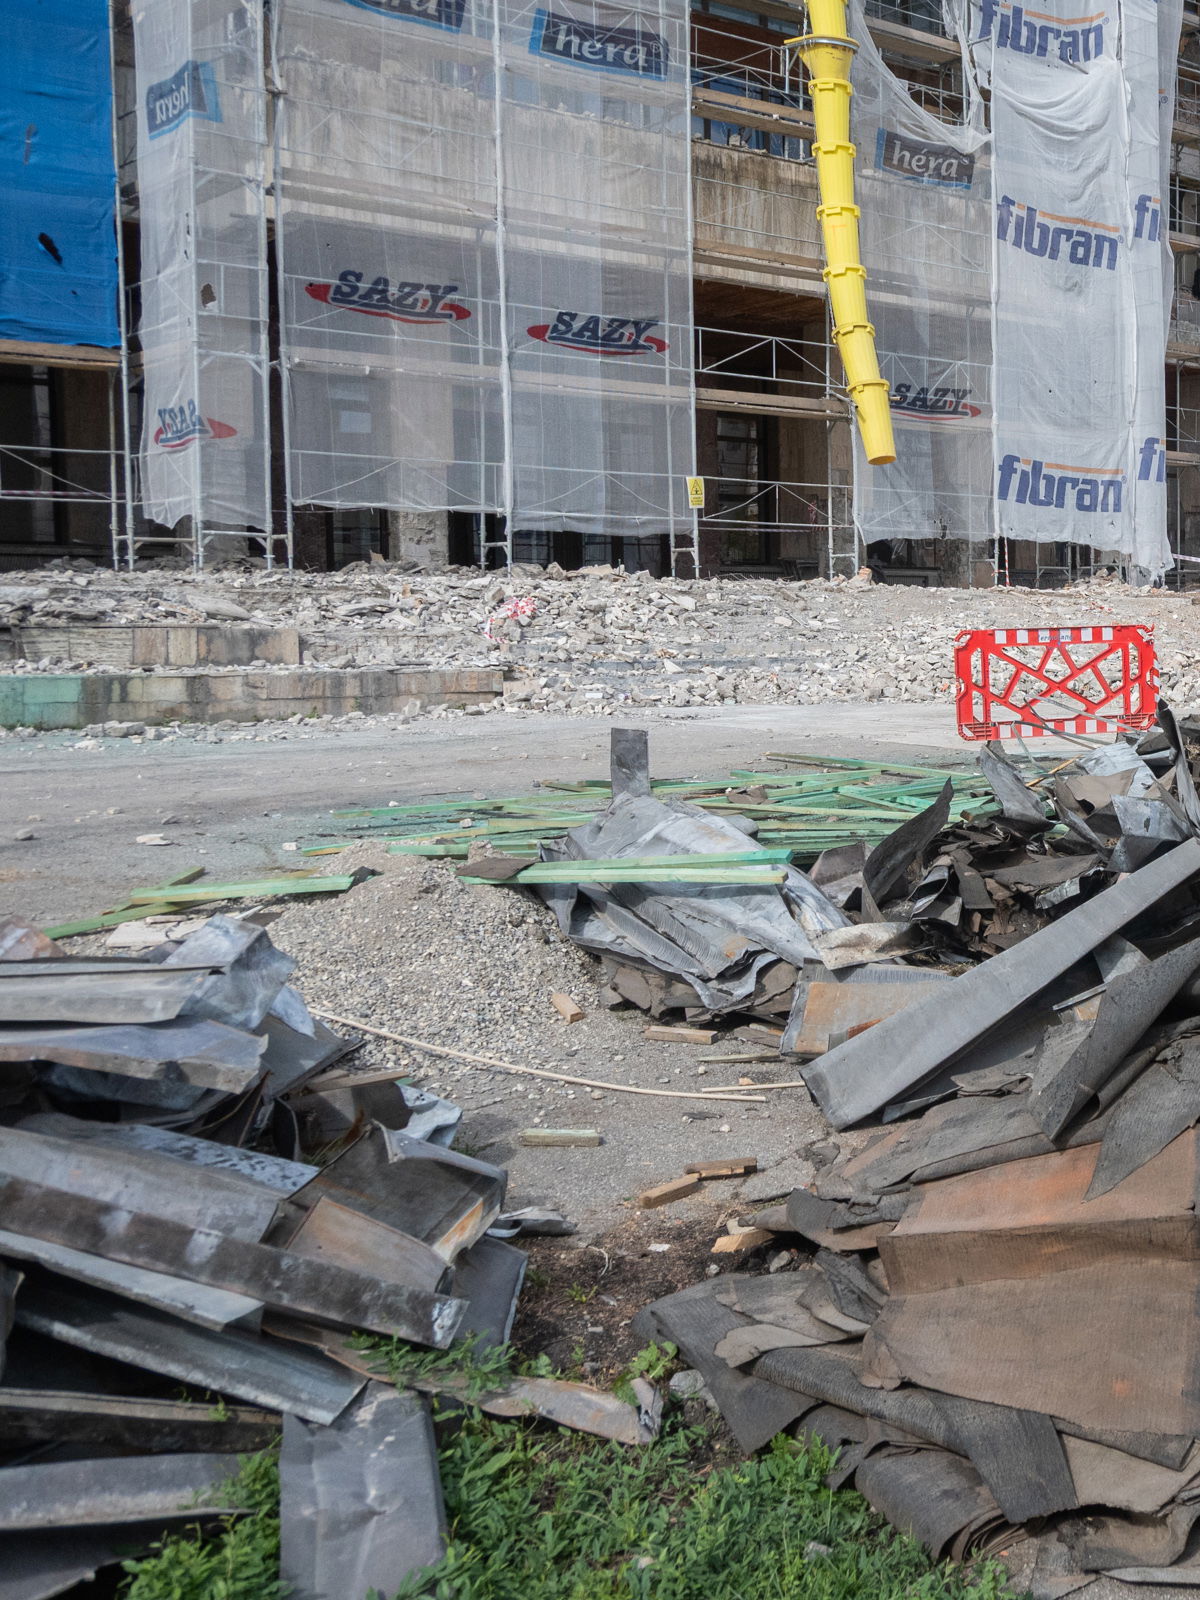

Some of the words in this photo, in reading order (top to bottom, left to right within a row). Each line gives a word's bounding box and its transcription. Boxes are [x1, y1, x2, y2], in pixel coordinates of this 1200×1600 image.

[978, 0, 1104, 63] fibran
[997, 194, 1119, 271] fibran
[331, 269, 459, 319] SAZY
[550, 310, 659, 350] SAZY
[890, 383, 973, 415] SAZY
[997, 453, 1123, 513] fibran
